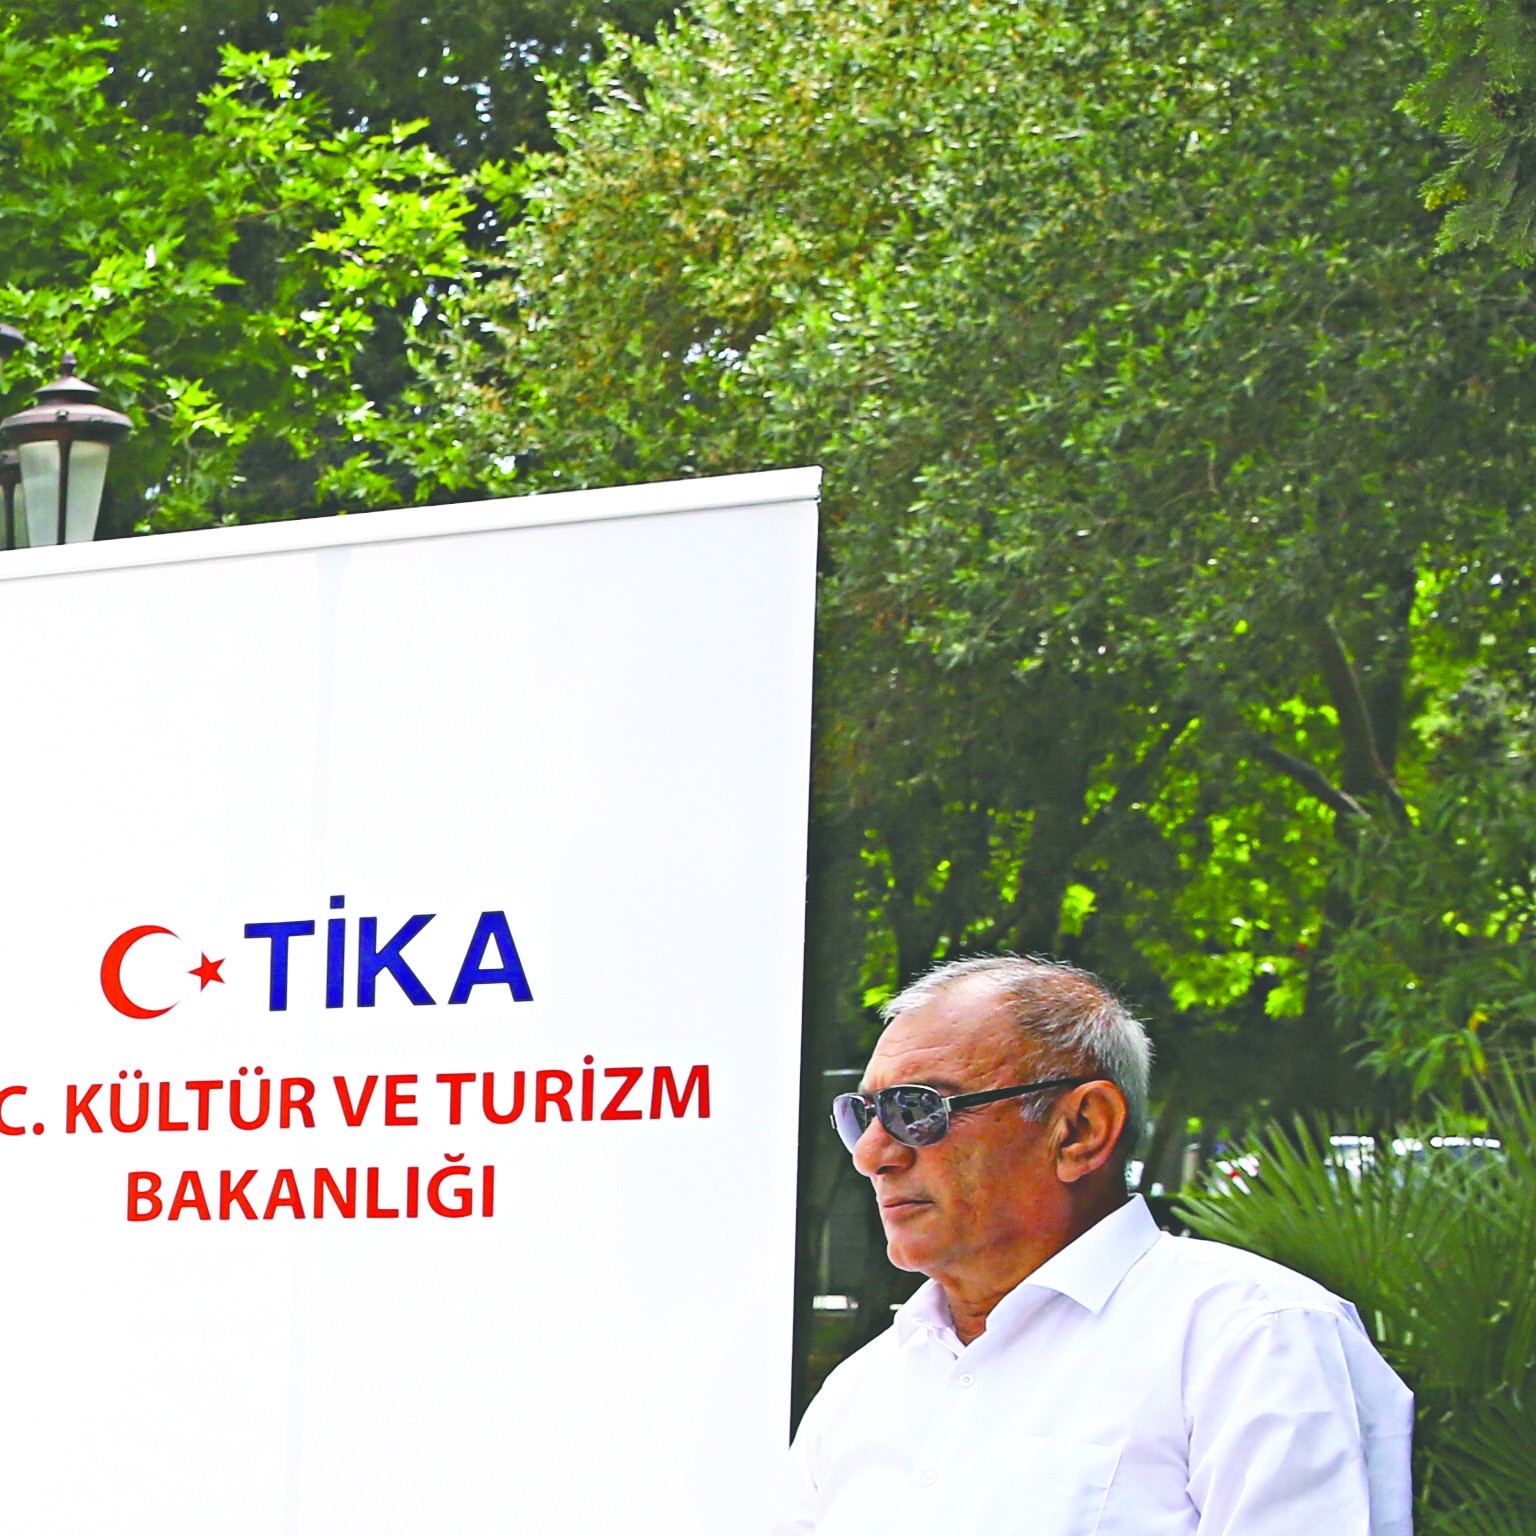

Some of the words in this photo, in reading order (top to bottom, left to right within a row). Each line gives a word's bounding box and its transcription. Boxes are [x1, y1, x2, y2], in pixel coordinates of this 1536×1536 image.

[244, 895, 534, 1012] TİKA
[65, 1066, 316, 1135] KÜLTÜR
[333, 1074, 418, 1127] VE
[436, 1055, 711, 1125] TURİZM
[128, 1154, 496, 1222] BAKANLIĞI
